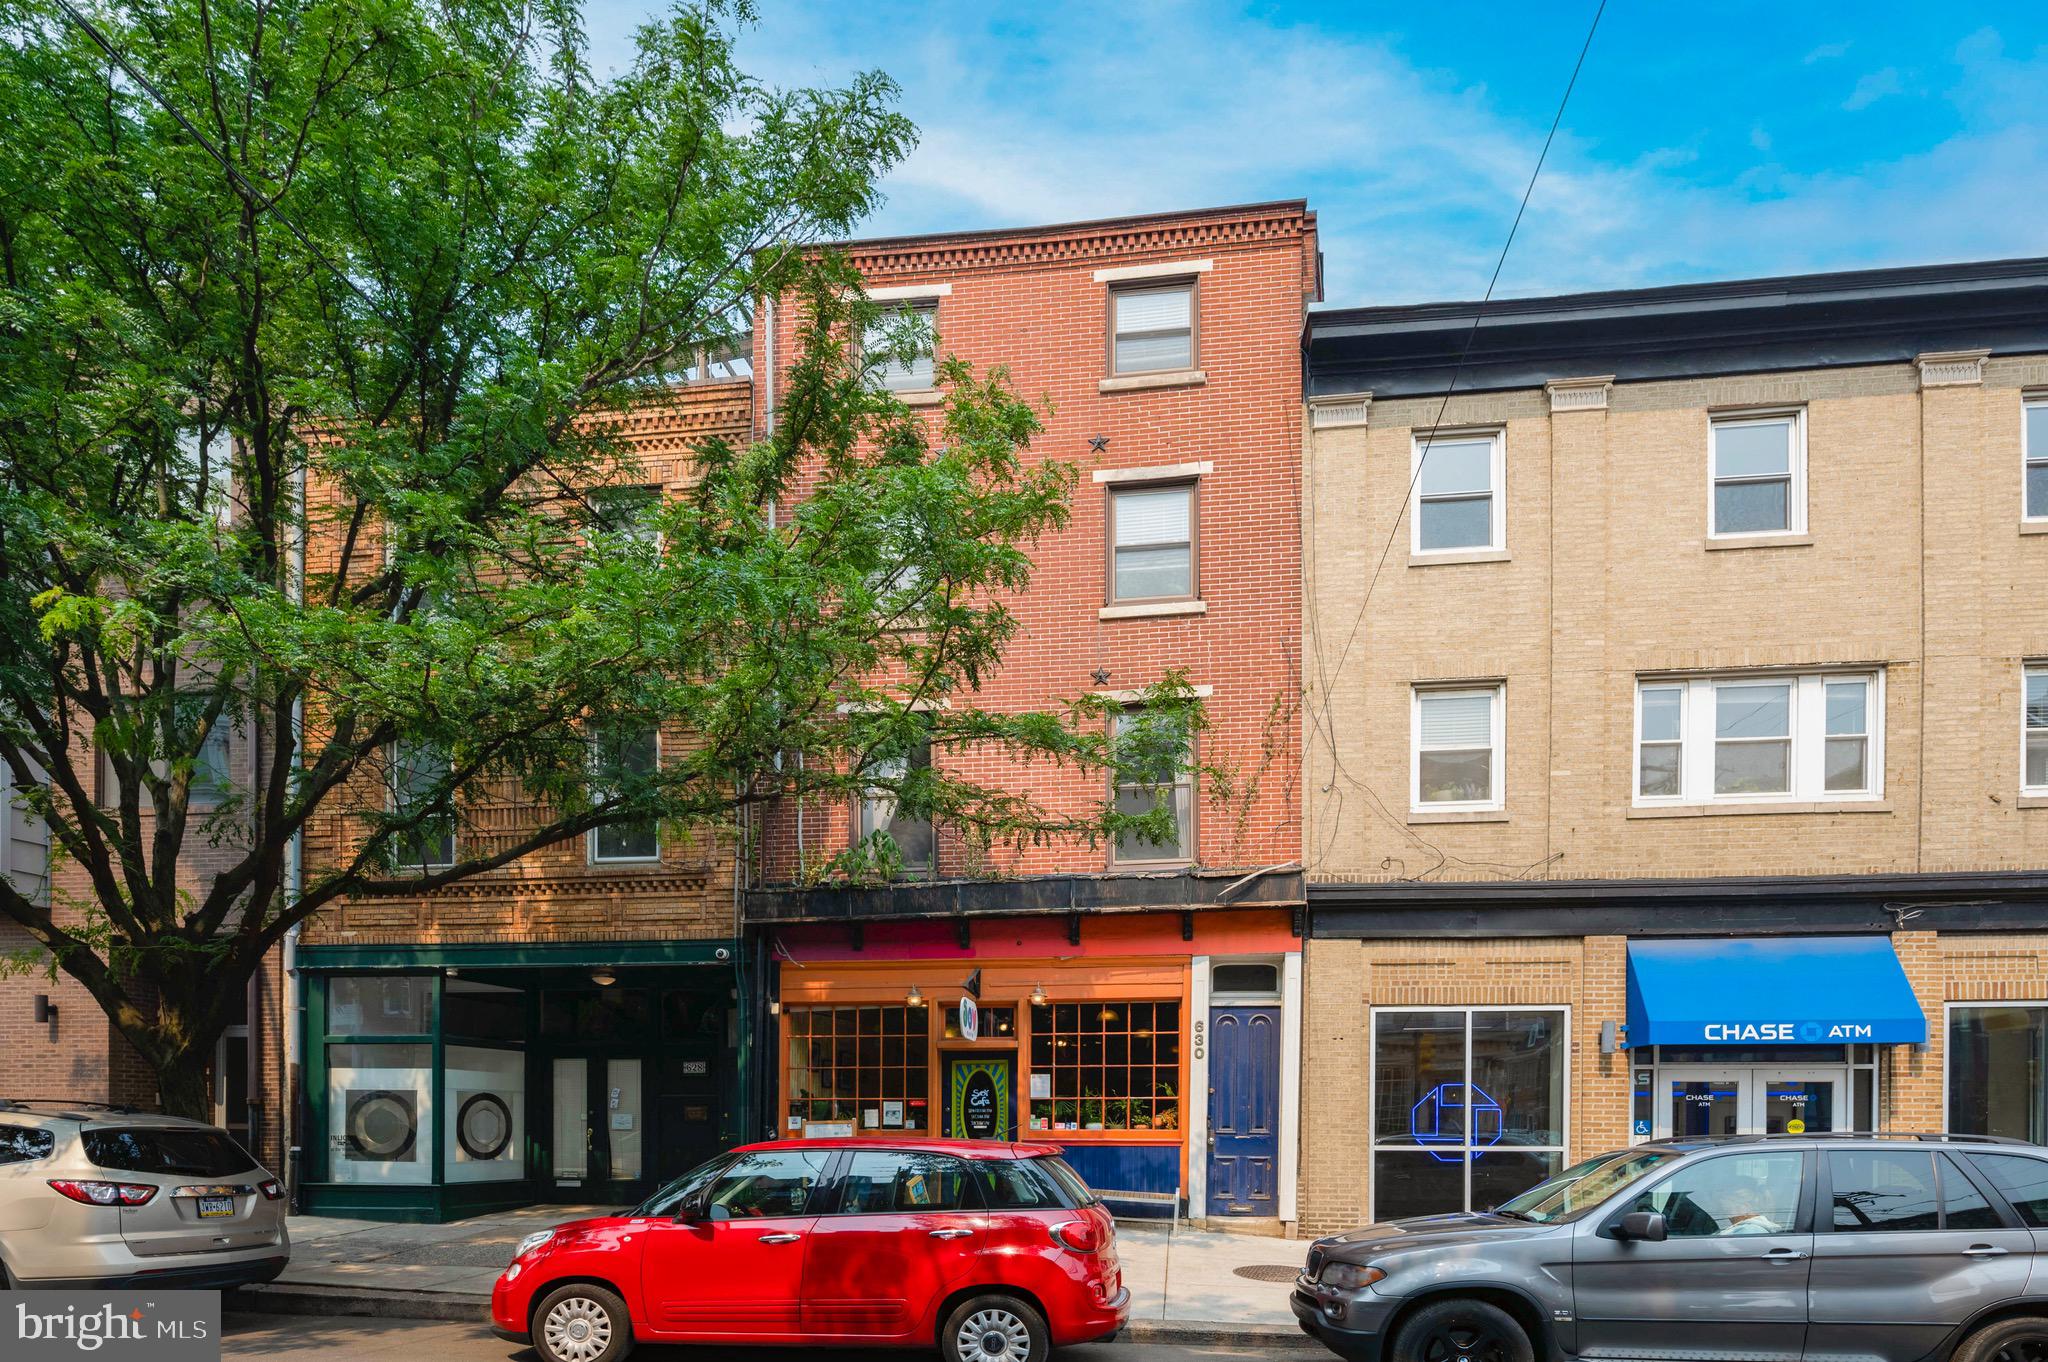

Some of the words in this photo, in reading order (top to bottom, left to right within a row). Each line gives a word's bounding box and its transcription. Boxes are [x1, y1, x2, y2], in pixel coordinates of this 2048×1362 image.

[1194, 1020, 1204, 1060] 630
[1704, 1023, 1795, 1041] CHASE
[1828, 1024, 1872, 1038] ATM
